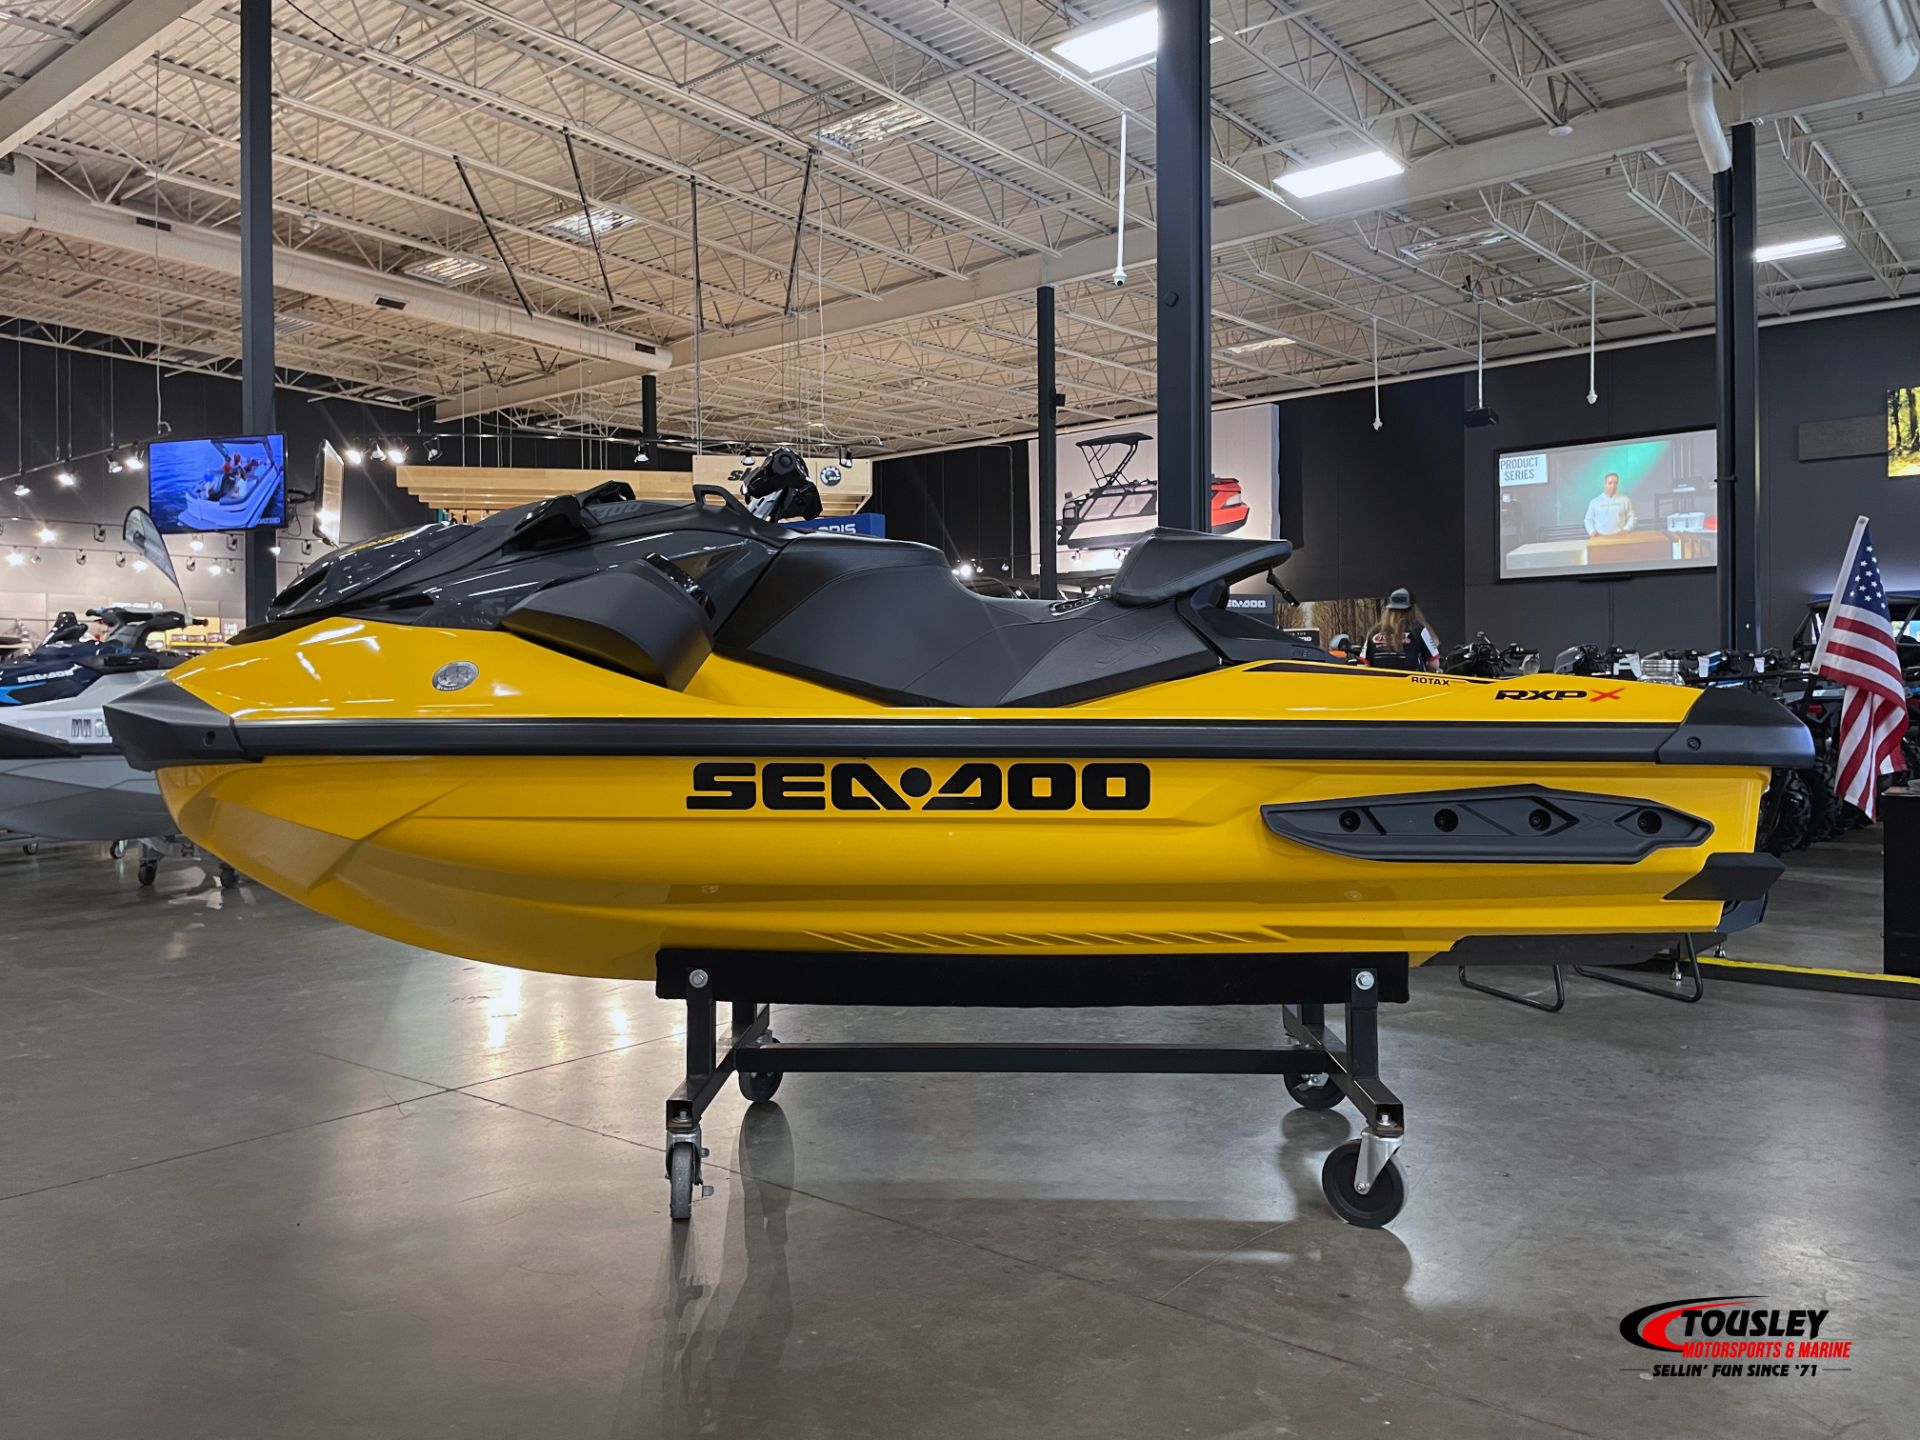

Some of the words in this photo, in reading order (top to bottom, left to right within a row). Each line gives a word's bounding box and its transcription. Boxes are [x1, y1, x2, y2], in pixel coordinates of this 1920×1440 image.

[1501, 457, 1539, 470] PRODUCT
[1504, 469, 1535, 481] SERIES
[1411, 676, 1450, 686] ROTAX
